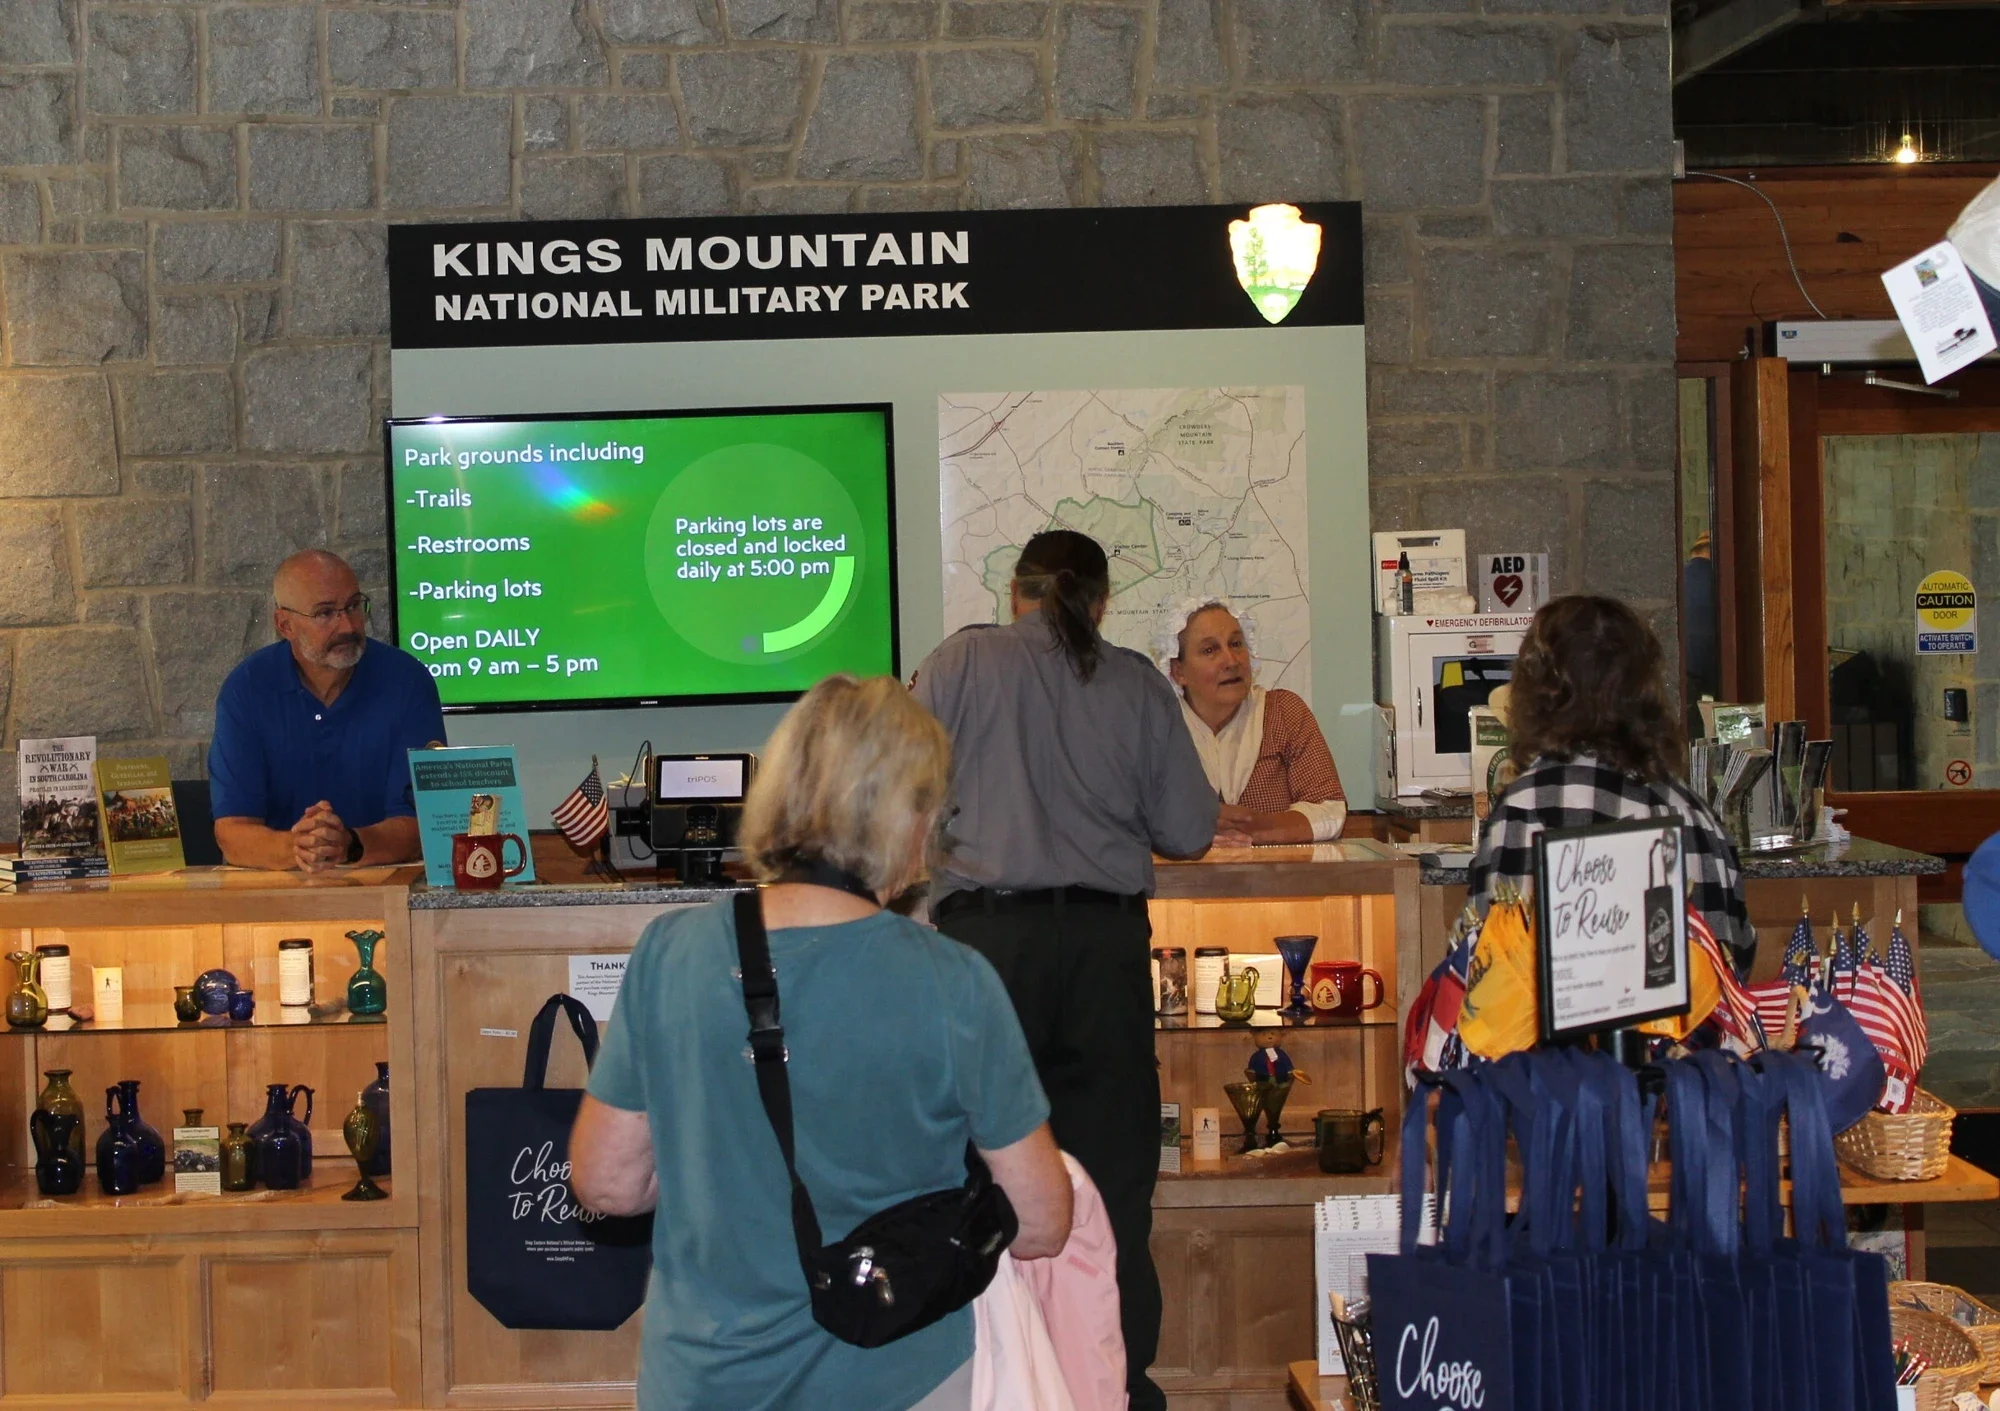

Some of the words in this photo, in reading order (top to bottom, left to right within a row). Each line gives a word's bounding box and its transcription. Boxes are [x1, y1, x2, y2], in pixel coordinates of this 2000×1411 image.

[433, 238, 622, 277] KINGS
[646, 230, 970, 272] MOUNTAIN
[434, 290, 642, 322] NATIONAL
[655, 284, 847, 316] MILITARY
[861, 281, 970, 312] PARK
[404, 448, 452, 468] Park
[457, 443, 544, 470] grounds
[549, 440, 645, 465] including
[406, 488, 472, 509] -Trails
[675, 517, 746, 538] Parking
[752, 515, 786, 533] lots
[792, 518, 823, 532] are
[408, 534, 531, 554] -Restrooms
[676, 538, 738, 557] closed
[743, 537, 778, 554] and
[783, 534, 846, 553] locked
[676, 560, 721, 583] daily
[726, 561, 746, 577] at
[750, 558, 795, 576] 5:00
[800, 562, 830, 580] pm
[1491, 556, 1525, 574] AED
[409, 581, 498, 604] -Parking
[503, 578, 543, 599] lots
[1922, 582, 1969, 592] AUTOMATIC
[1918, 594, 1973, 606] CAUTION
[1434, 618, 1478, 628] EMERGENCY
[1480, 616, 1533, 626] DEFIBRILLATOR
[1933, 611, 1958, 620] DOOR
[410, 631, 468, 653] Open
[474, 627, 540, 649] DAILY
[1920, 634, 1949, 642] ACTIVATE
[1950, 634, 1972, 642] SWITCH
[1938, 642, 1966, 650] OPERATE
[468, 658, 481, 676] 9
[486, 661, 520, 675] am
[546, 655, 560, 673] 5
[566, 658, 598, 677] pm
[25, 752, 91, 763] REVOLUTIONARY
[416, 762, 454, 770] America's
[456, 760, 488, 768] National
[490, 759, 512, 767] Parks
[37, 774, 56, 782] SOUTH
[58, 773, 88, 781] CAROLINA
[49, 764, 68, 772] WAR
[420, 772, 452, 780] extends
[468, 778, 502, 786] teachers
[1556, 838, 1616, 892] Choose
[1575, 888, 1630, 940] Reuse
[590, 962, 626, 970] THANK
[510, 1140, 573, 1184] Choo
[1396, 1316, 1486, 1410] Choose
